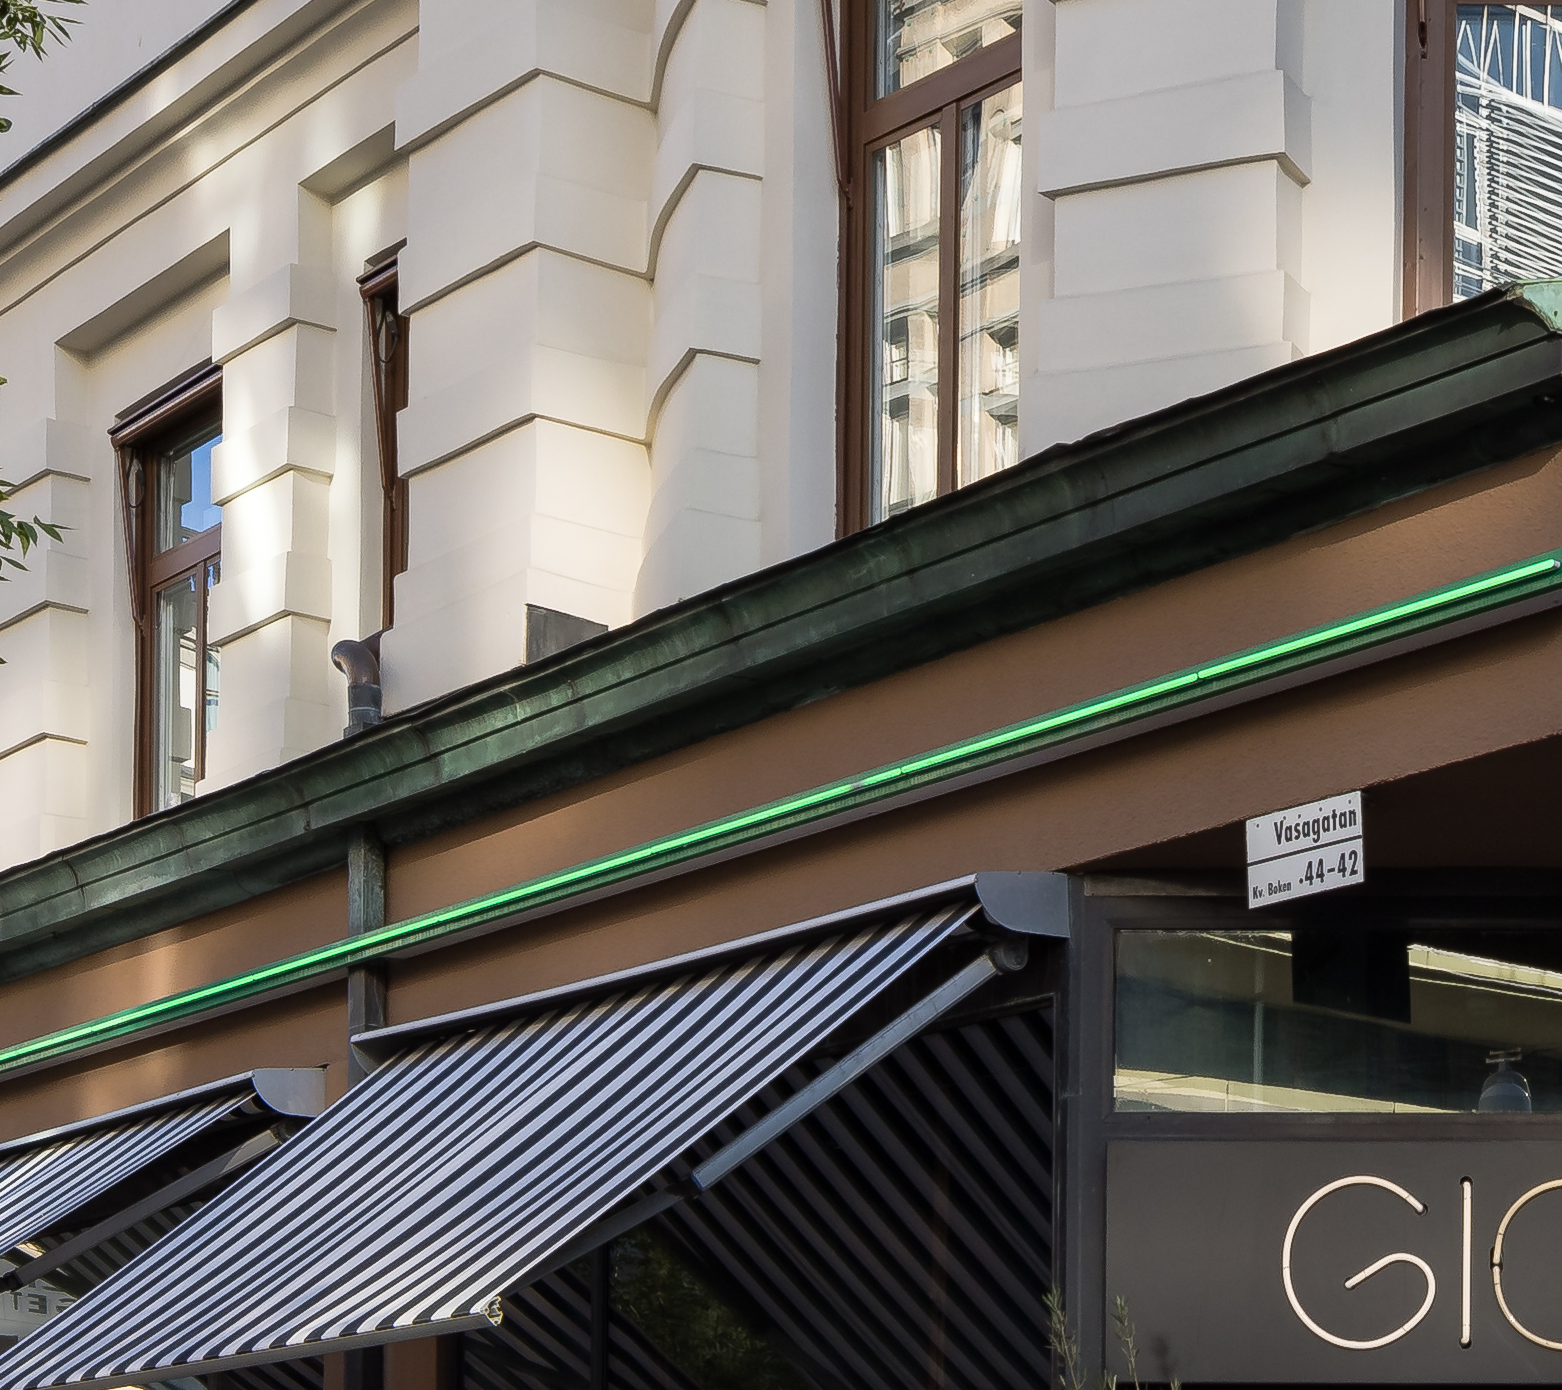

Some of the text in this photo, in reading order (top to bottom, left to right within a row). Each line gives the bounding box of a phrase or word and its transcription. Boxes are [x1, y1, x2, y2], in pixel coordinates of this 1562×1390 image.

[1273, 809, 1357, 846] Vasagatan
[1252, 880, 1292, 900] Kv. Boken
